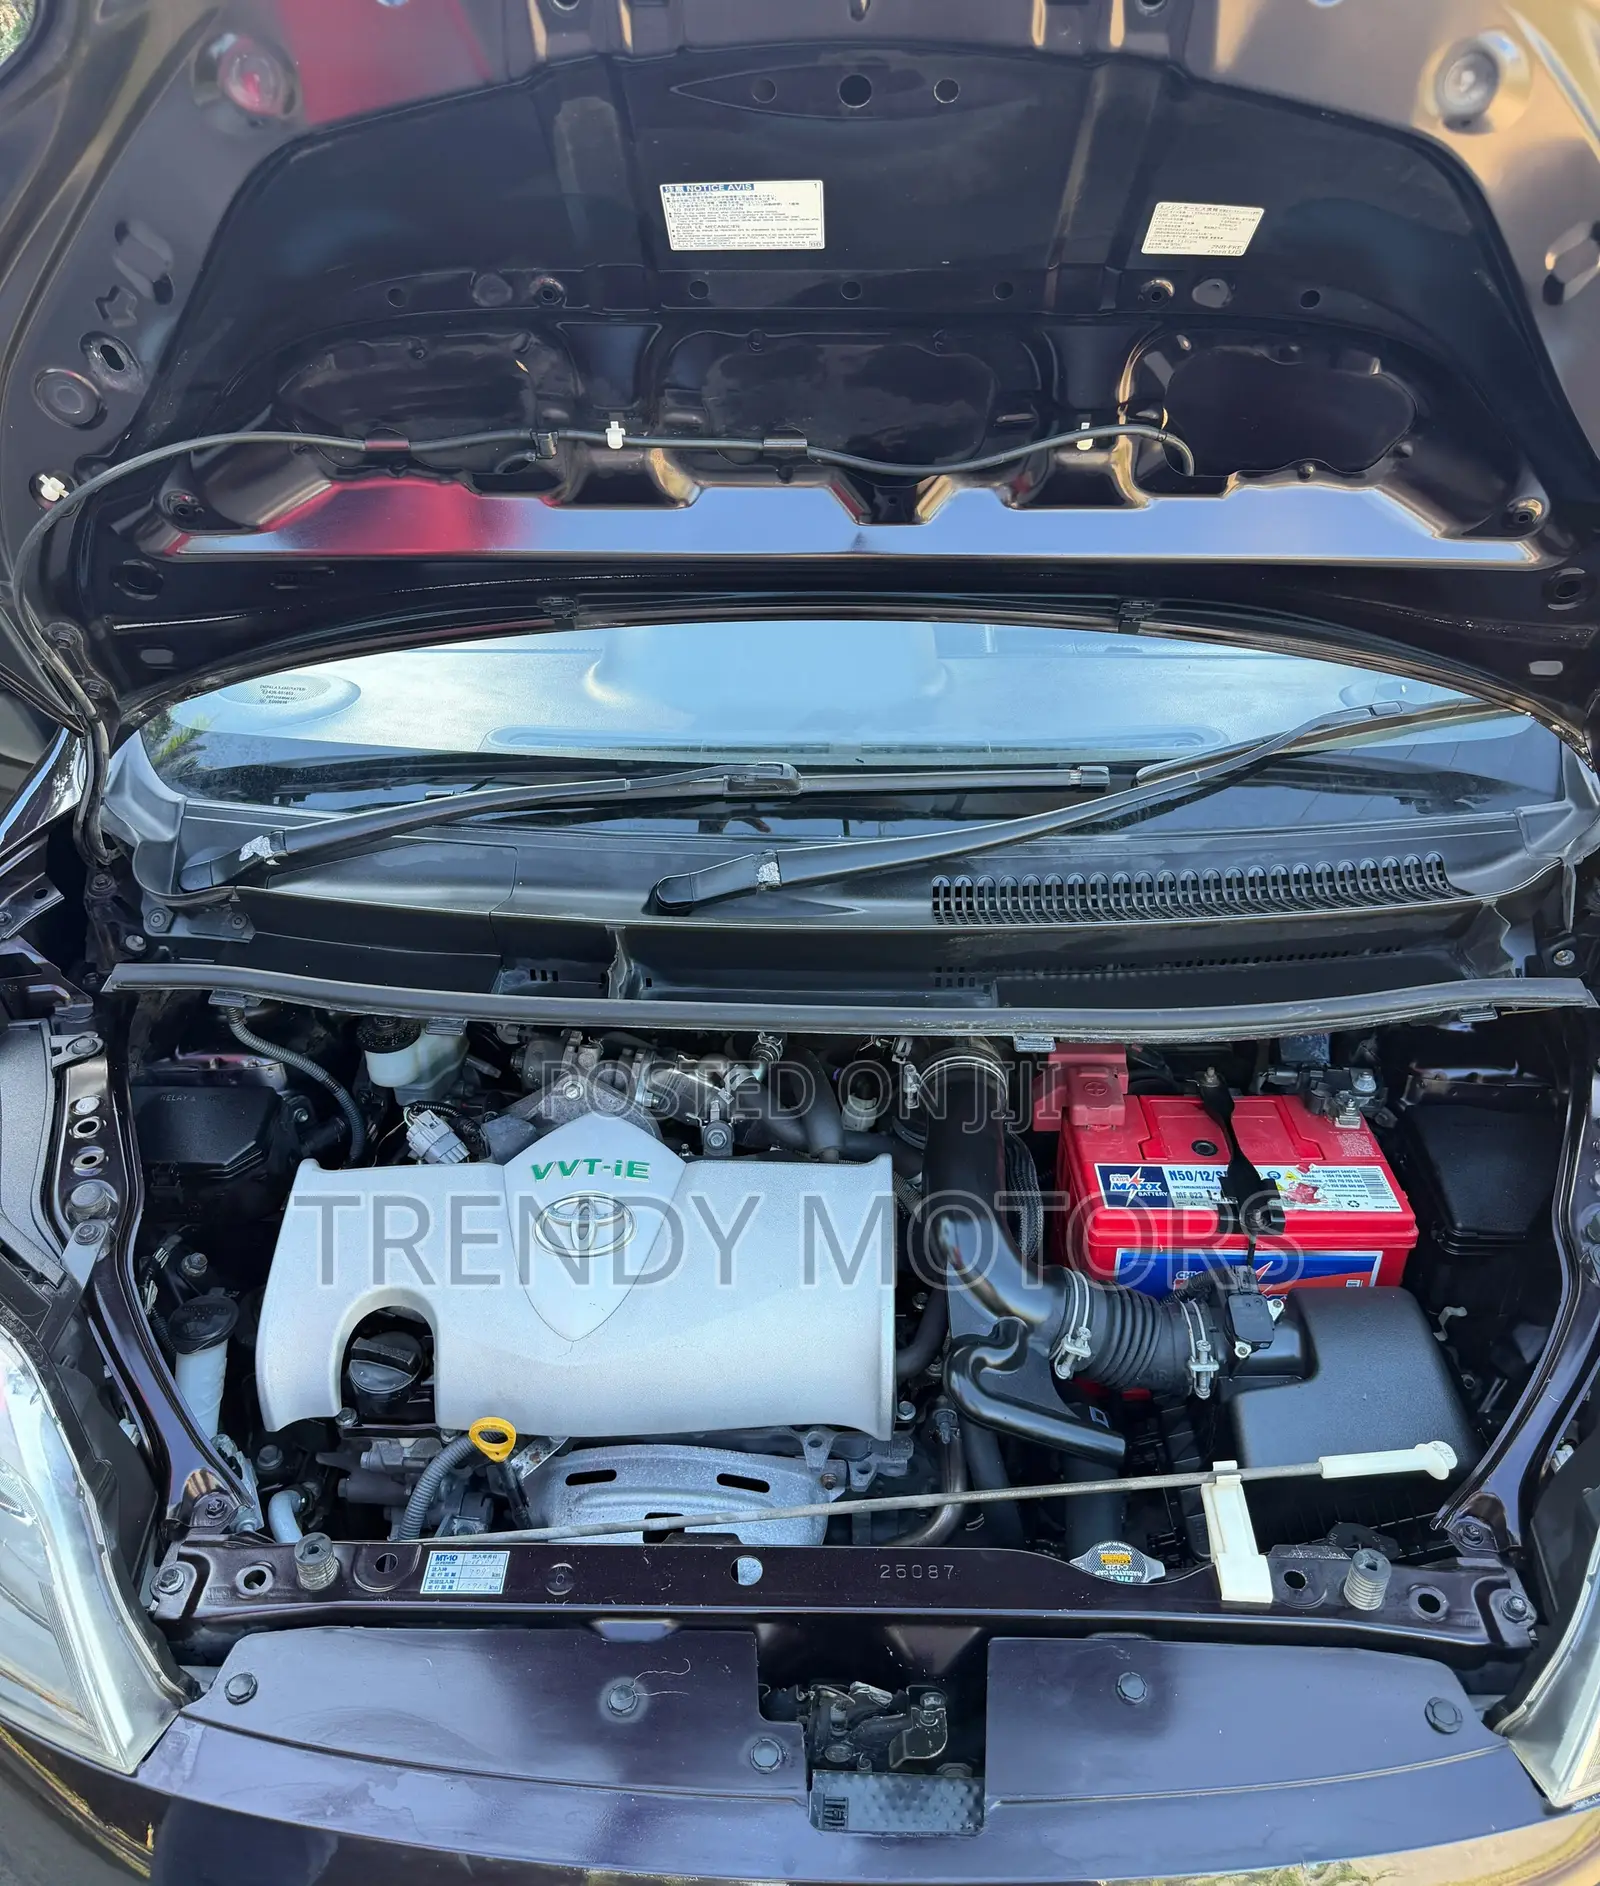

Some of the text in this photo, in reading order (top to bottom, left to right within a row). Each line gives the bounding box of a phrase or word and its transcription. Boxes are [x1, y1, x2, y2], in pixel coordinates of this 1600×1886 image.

[687, 183, 753, 193] NOTICE AVIS
[531, 1158, 651, 1182] VVT-iE
[1112, 1182, 1160, 1191] MAXX
[435, 1554, 458, 1562] MT-10
[880, 1564, 955, 1580] 25087
